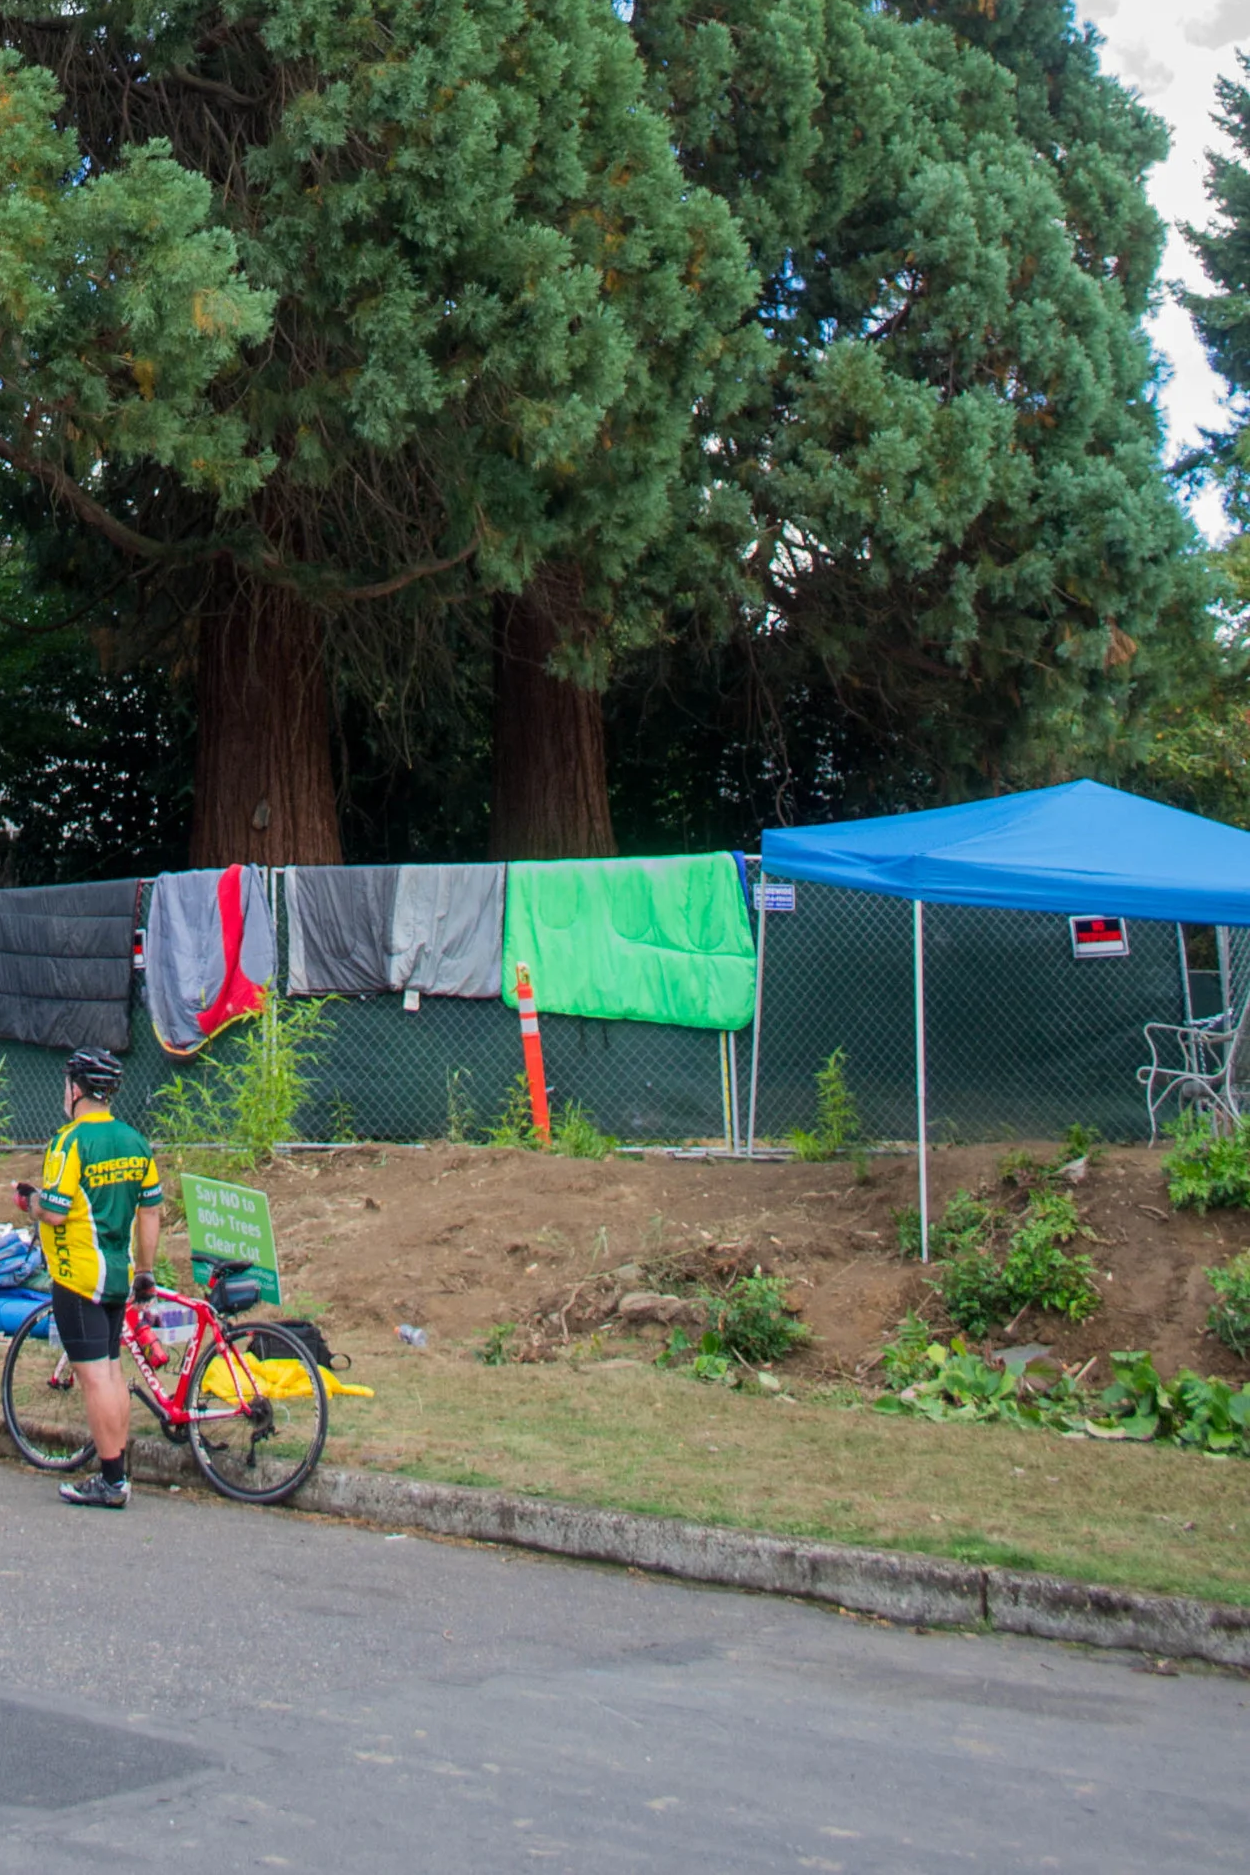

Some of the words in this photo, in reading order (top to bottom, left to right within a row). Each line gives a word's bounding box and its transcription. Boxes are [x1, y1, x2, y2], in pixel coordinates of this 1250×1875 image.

[84, 1156, 149, 1178] OREGON
[88, 1169, 144, 1189] DUCKS
[195, 1183, 217, 1208] Say
[219, 1188, 240, 1209] NO
[242, 1197, 256, 1213] to
[197, 1207, 225, 1228] 800+
[227, 1214, 262, 1240] Trees
[53, 1224, 73, 1279] DUCKS
[204, 1232, 236, 1255] Clear
[239, 1241, 261, 1263] Cut
